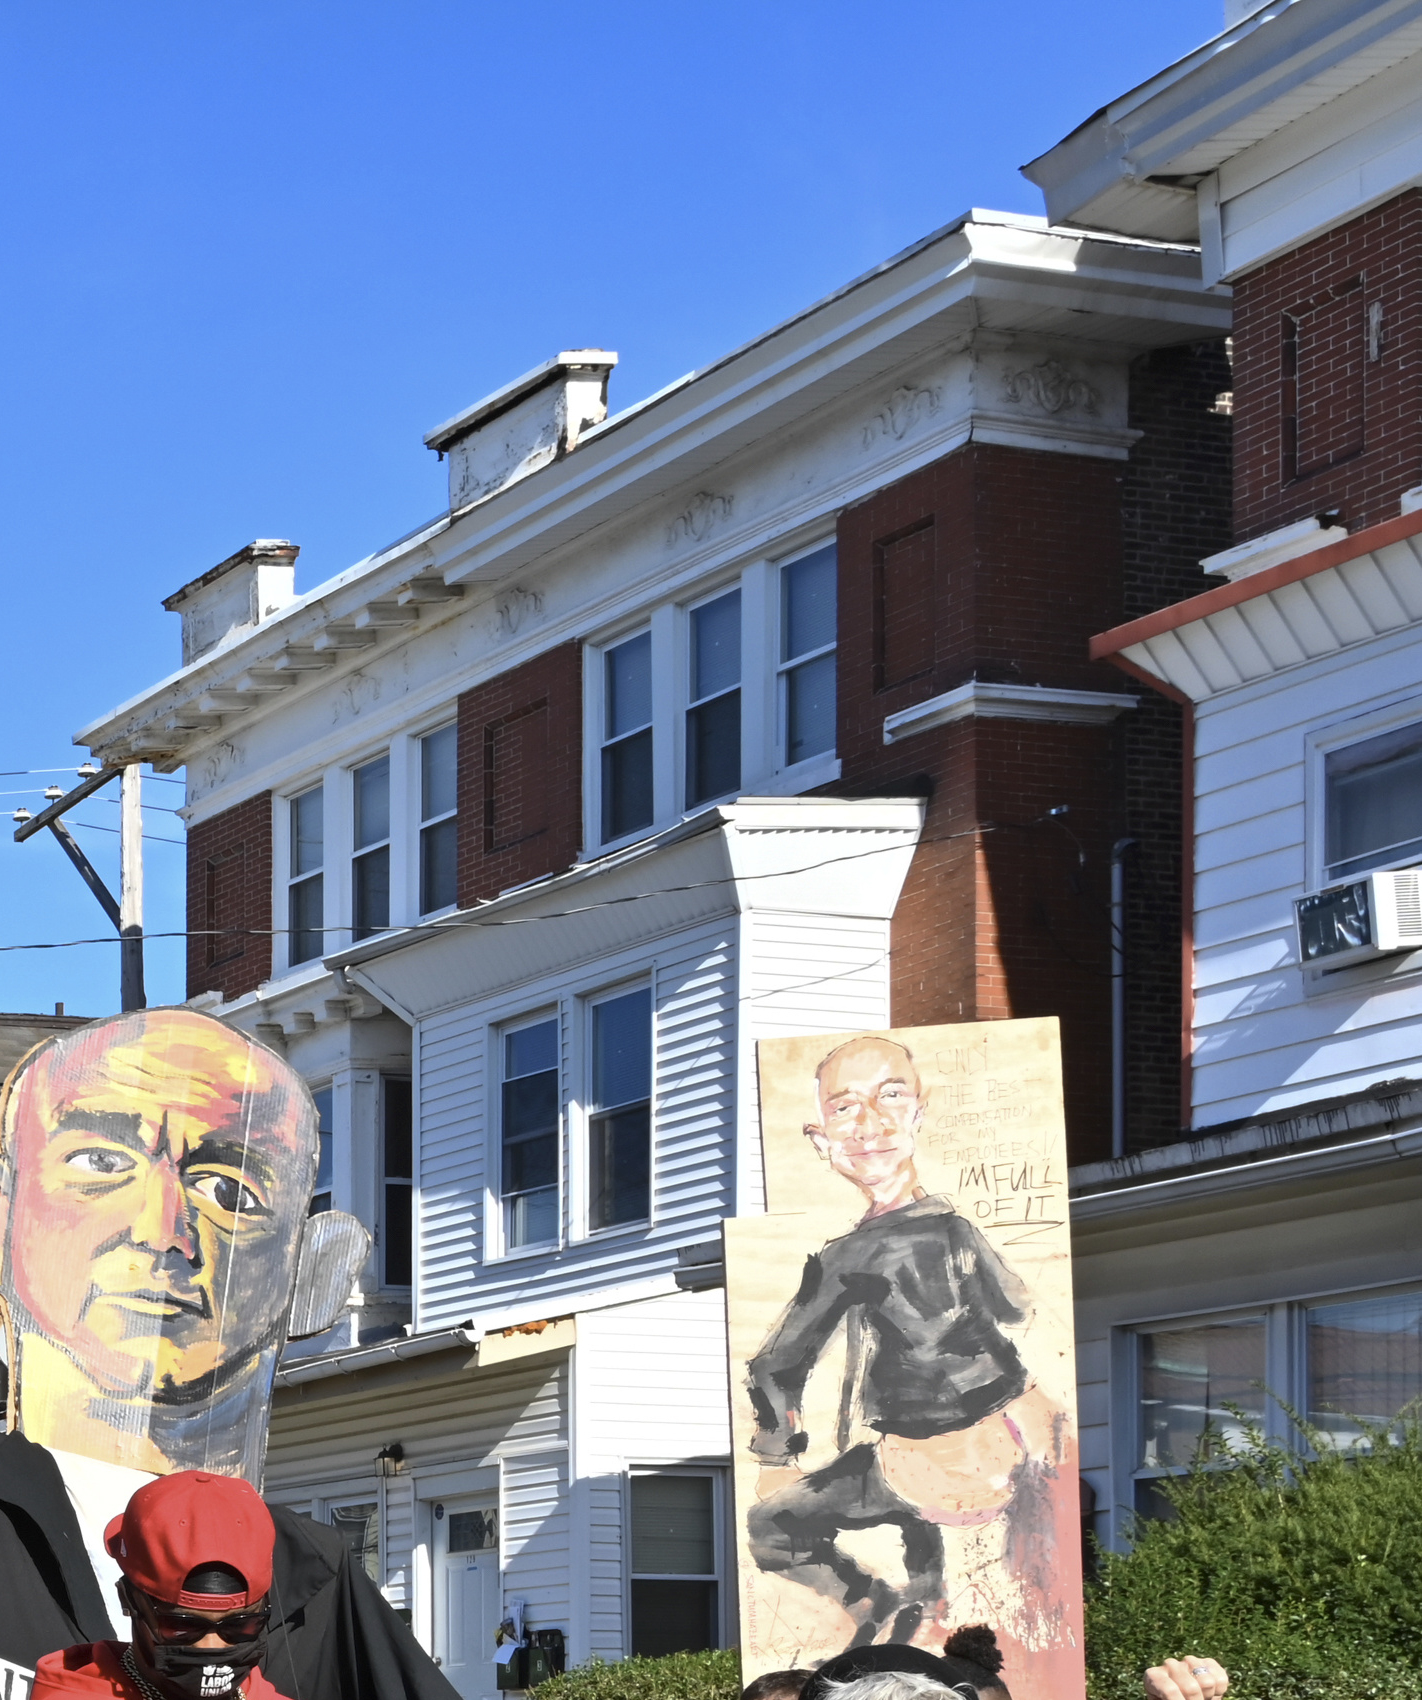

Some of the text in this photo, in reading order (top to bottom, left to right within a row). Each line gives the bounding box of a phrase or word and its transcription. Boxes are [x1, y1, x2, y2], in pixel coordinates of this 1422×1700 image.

[939, 1078, 1042, 1105] THE BEST
[936, 1104, 1033, 1129] COMPENSATION
[928, 1128, 996, 1148] FOR MY
[991, 1161, 1063, 1196] FULL
[973, 1194, 1055, 1222] OF IT
